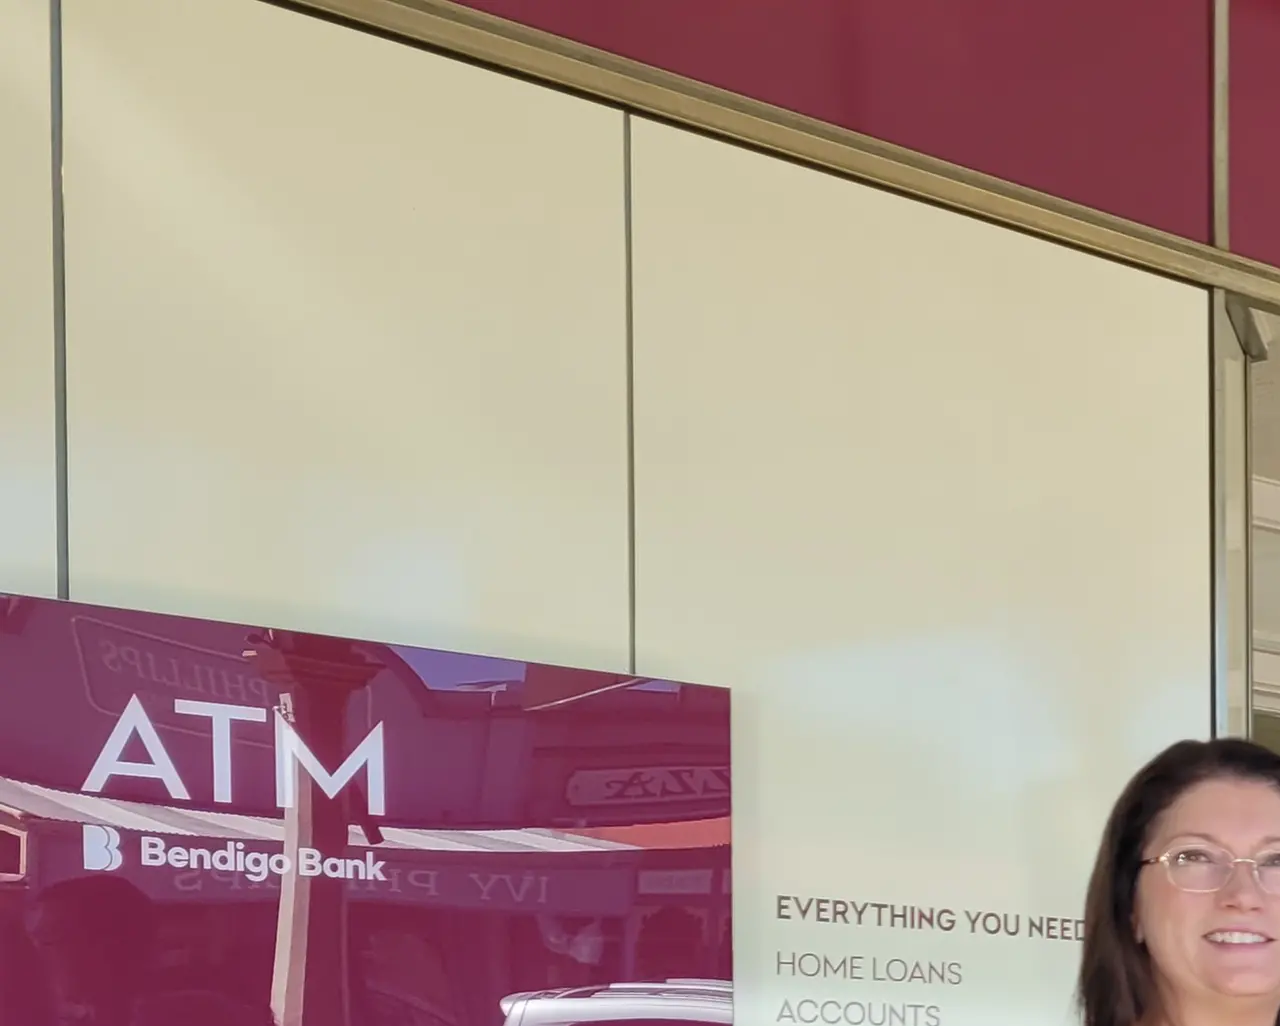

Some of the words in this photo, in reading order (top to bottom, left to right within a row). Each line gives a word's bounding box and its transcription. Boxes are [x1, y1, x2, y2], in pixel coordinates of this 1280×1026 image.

[81, 693, 386, 816] ATM
[140, 836, 292, 882] Bendigo
[299, 847, 388, 881] Bank
[777, 895, 957, 932] EVERYTHING
[965, 909, 1020, 936] YOU
[777, 951, 864, 980] HOME
[872, 957, 963, 985] LOANS
